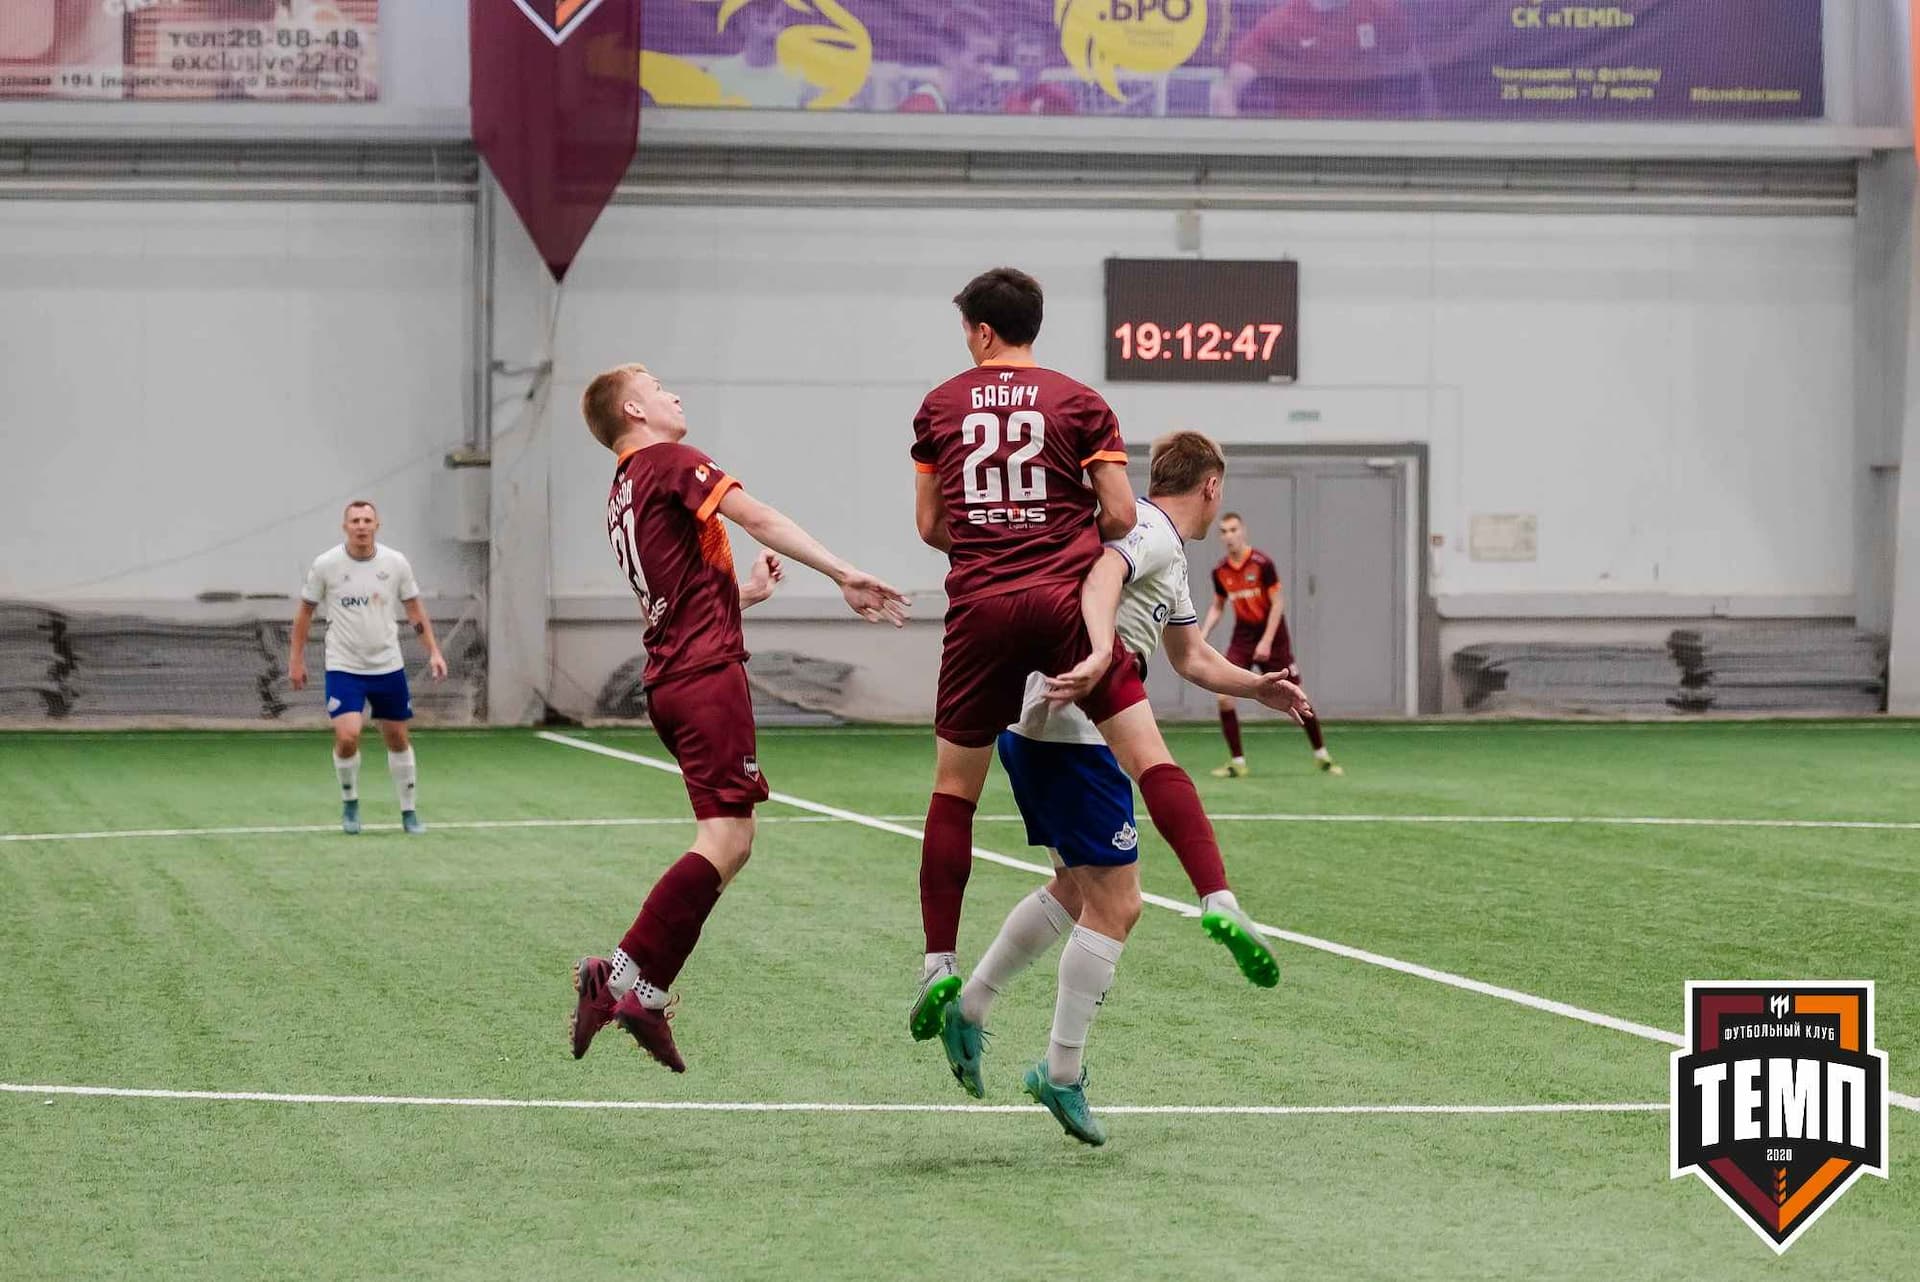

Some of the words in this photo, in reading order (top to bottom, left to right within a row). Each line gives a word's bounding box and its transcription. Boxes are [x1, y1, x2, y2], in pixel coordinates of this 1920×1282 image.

[1512, 6, 1542, 28] СК
[1547, 7, 1634, 28] «ТЕМП»
[1115, 322, 1283, 361] 19:12:47
[971, 385, 1039, 409] БАБИЧ
[961, 411, 1047, 504] 22
[967, 507, 1047, 525] SEUS
